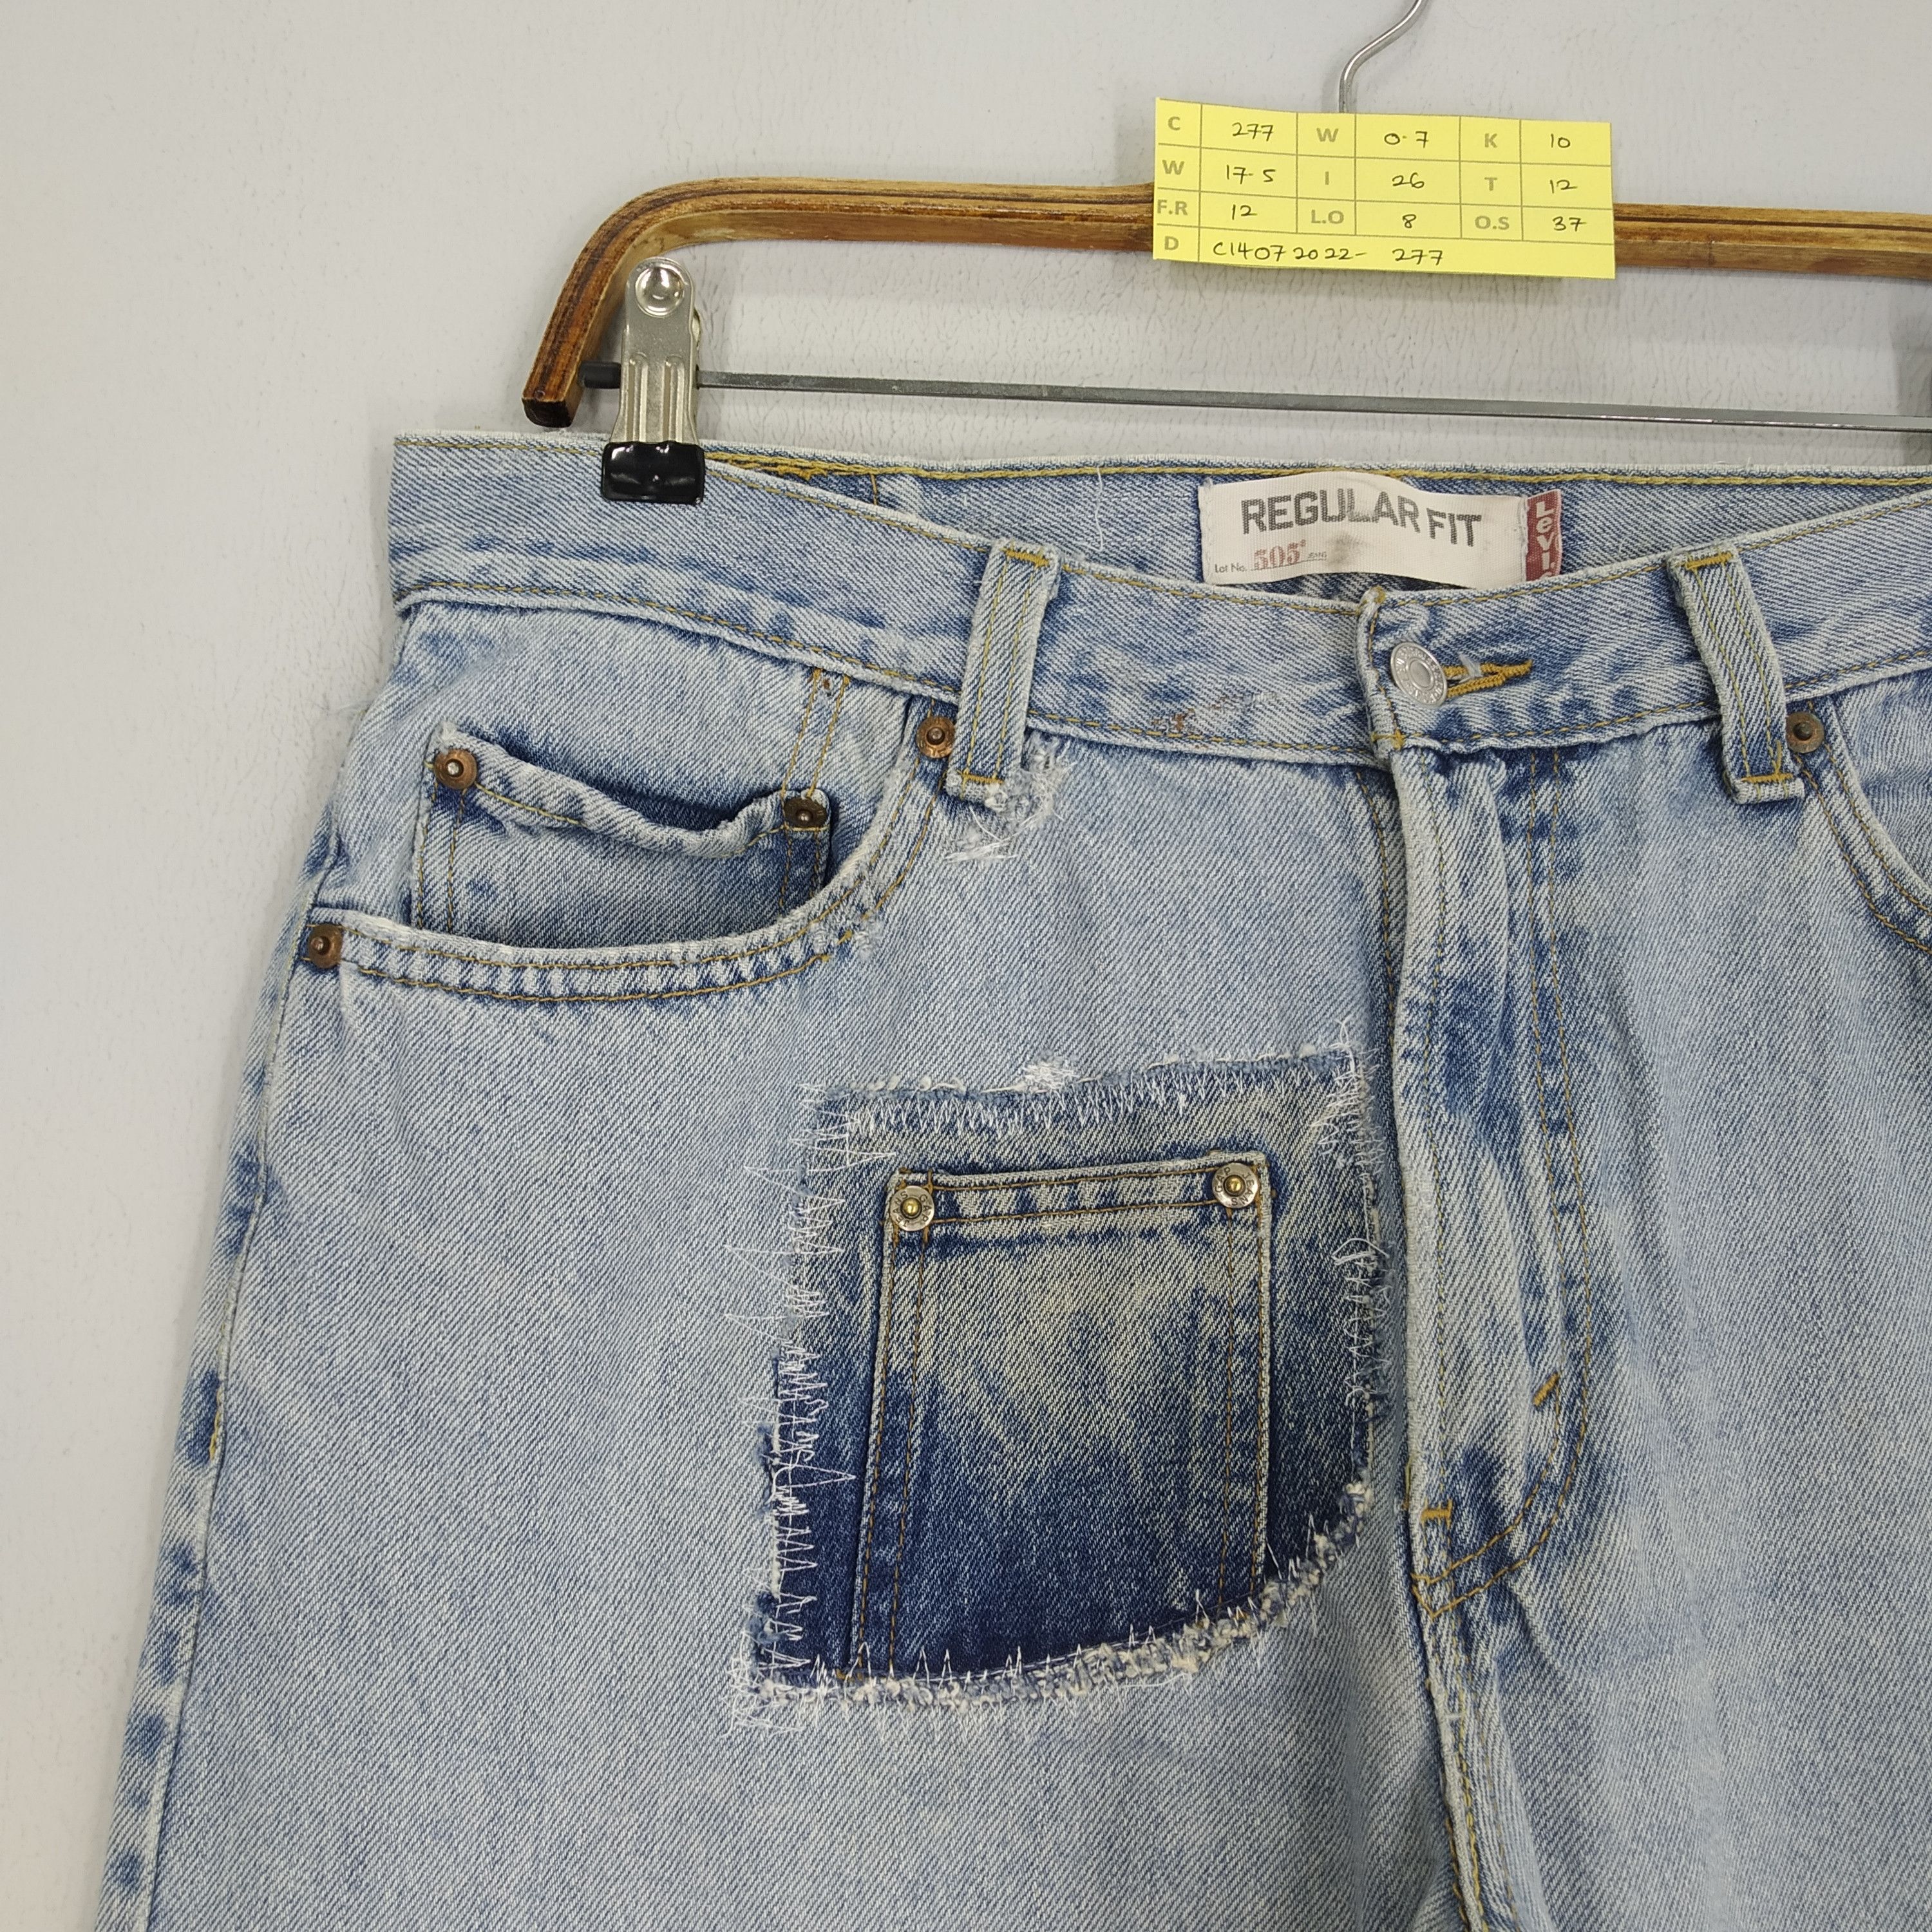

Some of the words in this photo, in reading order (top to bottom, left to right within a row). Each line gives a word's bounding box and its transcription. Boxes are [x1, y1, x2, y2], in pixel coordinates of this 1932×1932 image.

[1168, 116, 1180, 131] C
[1231, 122, 1274, 142] 277
[1316, 128, 1339, 143] W
[1484, 133, 1498, 149] K
[1550, 133, 1571, 149] 10
[1162, 159, 1185, 176] W
[1325, 171, 1330, 185] I
[1391, 171, 1425, 189] 26
[1484, 176, 1498, 191] T
[1549, 179, 1578, 194] 12
[1157, 199, 1188, 216] F.R
[1231, 204, 1258, 221] 12
[1311, 209, 1345, 225] L.O
[1401, 213, 1417, 229] 8
[1474, 215, 1510, 231] O.S
[1552, 216, 1587, 232] 37
[1164, 235, 1179, 251] D
[1392, 248, 1443, 266] 277
[1240, 488, 1420, 535] REGULAR
[1426, 507, 1482, 547] FIT
[1215, 564, 1228, 573] Lot
[1231, 562, 1247, 573] No.
[1215, 1166, 1231, 1193] GAP
[1231, 1172, 1255, 1206] JEANS
[893, 1191, 910, 1227] JEANS
[919, 1194, 932, 1222] GAP
